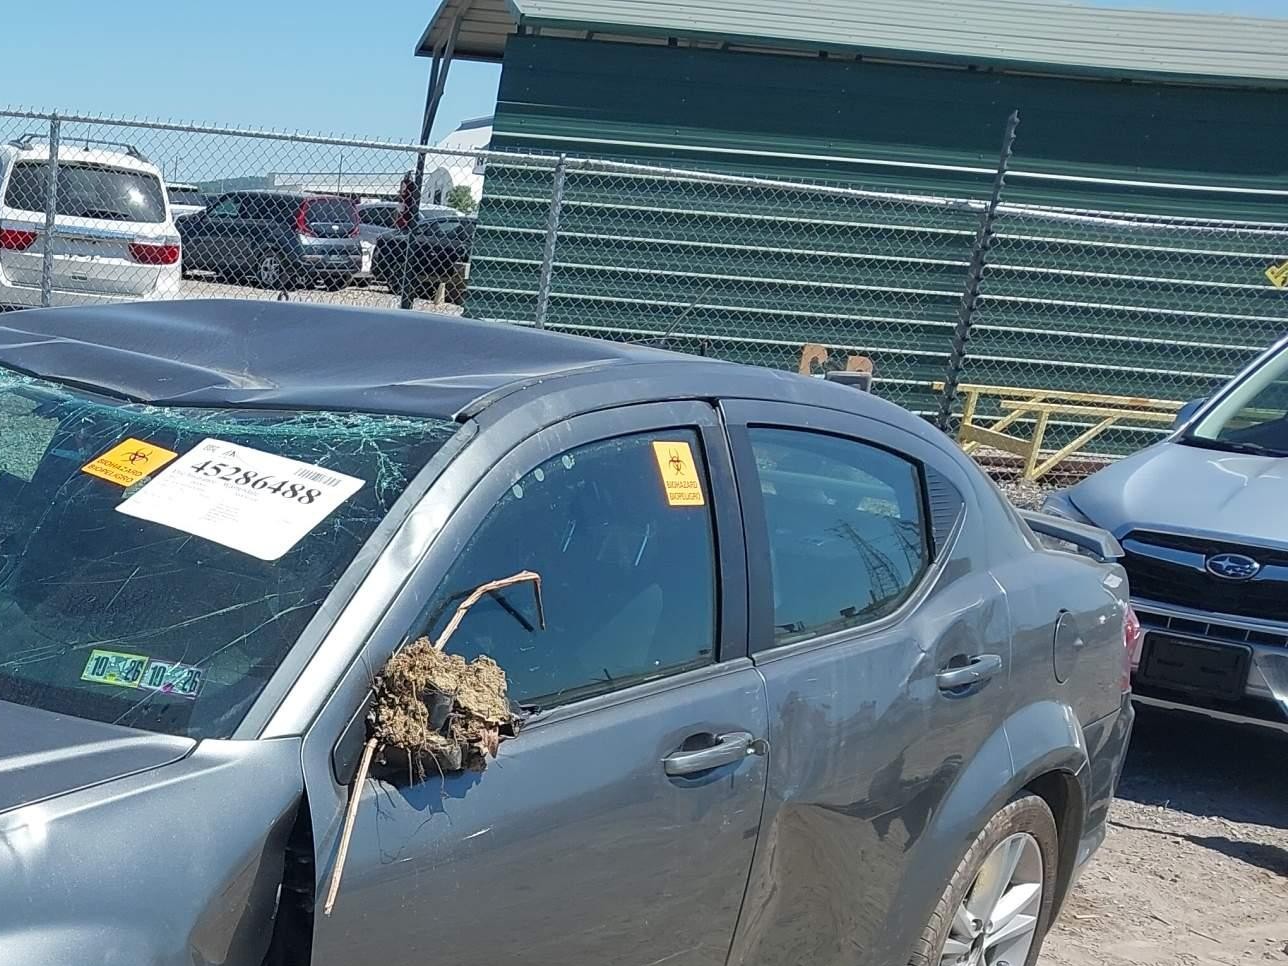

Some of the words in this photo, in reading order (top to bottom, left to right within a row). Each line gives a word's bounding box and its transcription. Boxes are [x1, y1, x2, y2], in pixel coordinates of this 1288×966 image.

[87, 464, 134, 483] BIOPELIGRO
[97, 459, 142, 477] BIOHAZARD
[191, 460, 322, 504] 45286488
[91, 656, 110, 676] 10
[124, 660, 144, 681] 26
[148, 666, 167, 687] 10
[182, 670, 202, 692] 26
